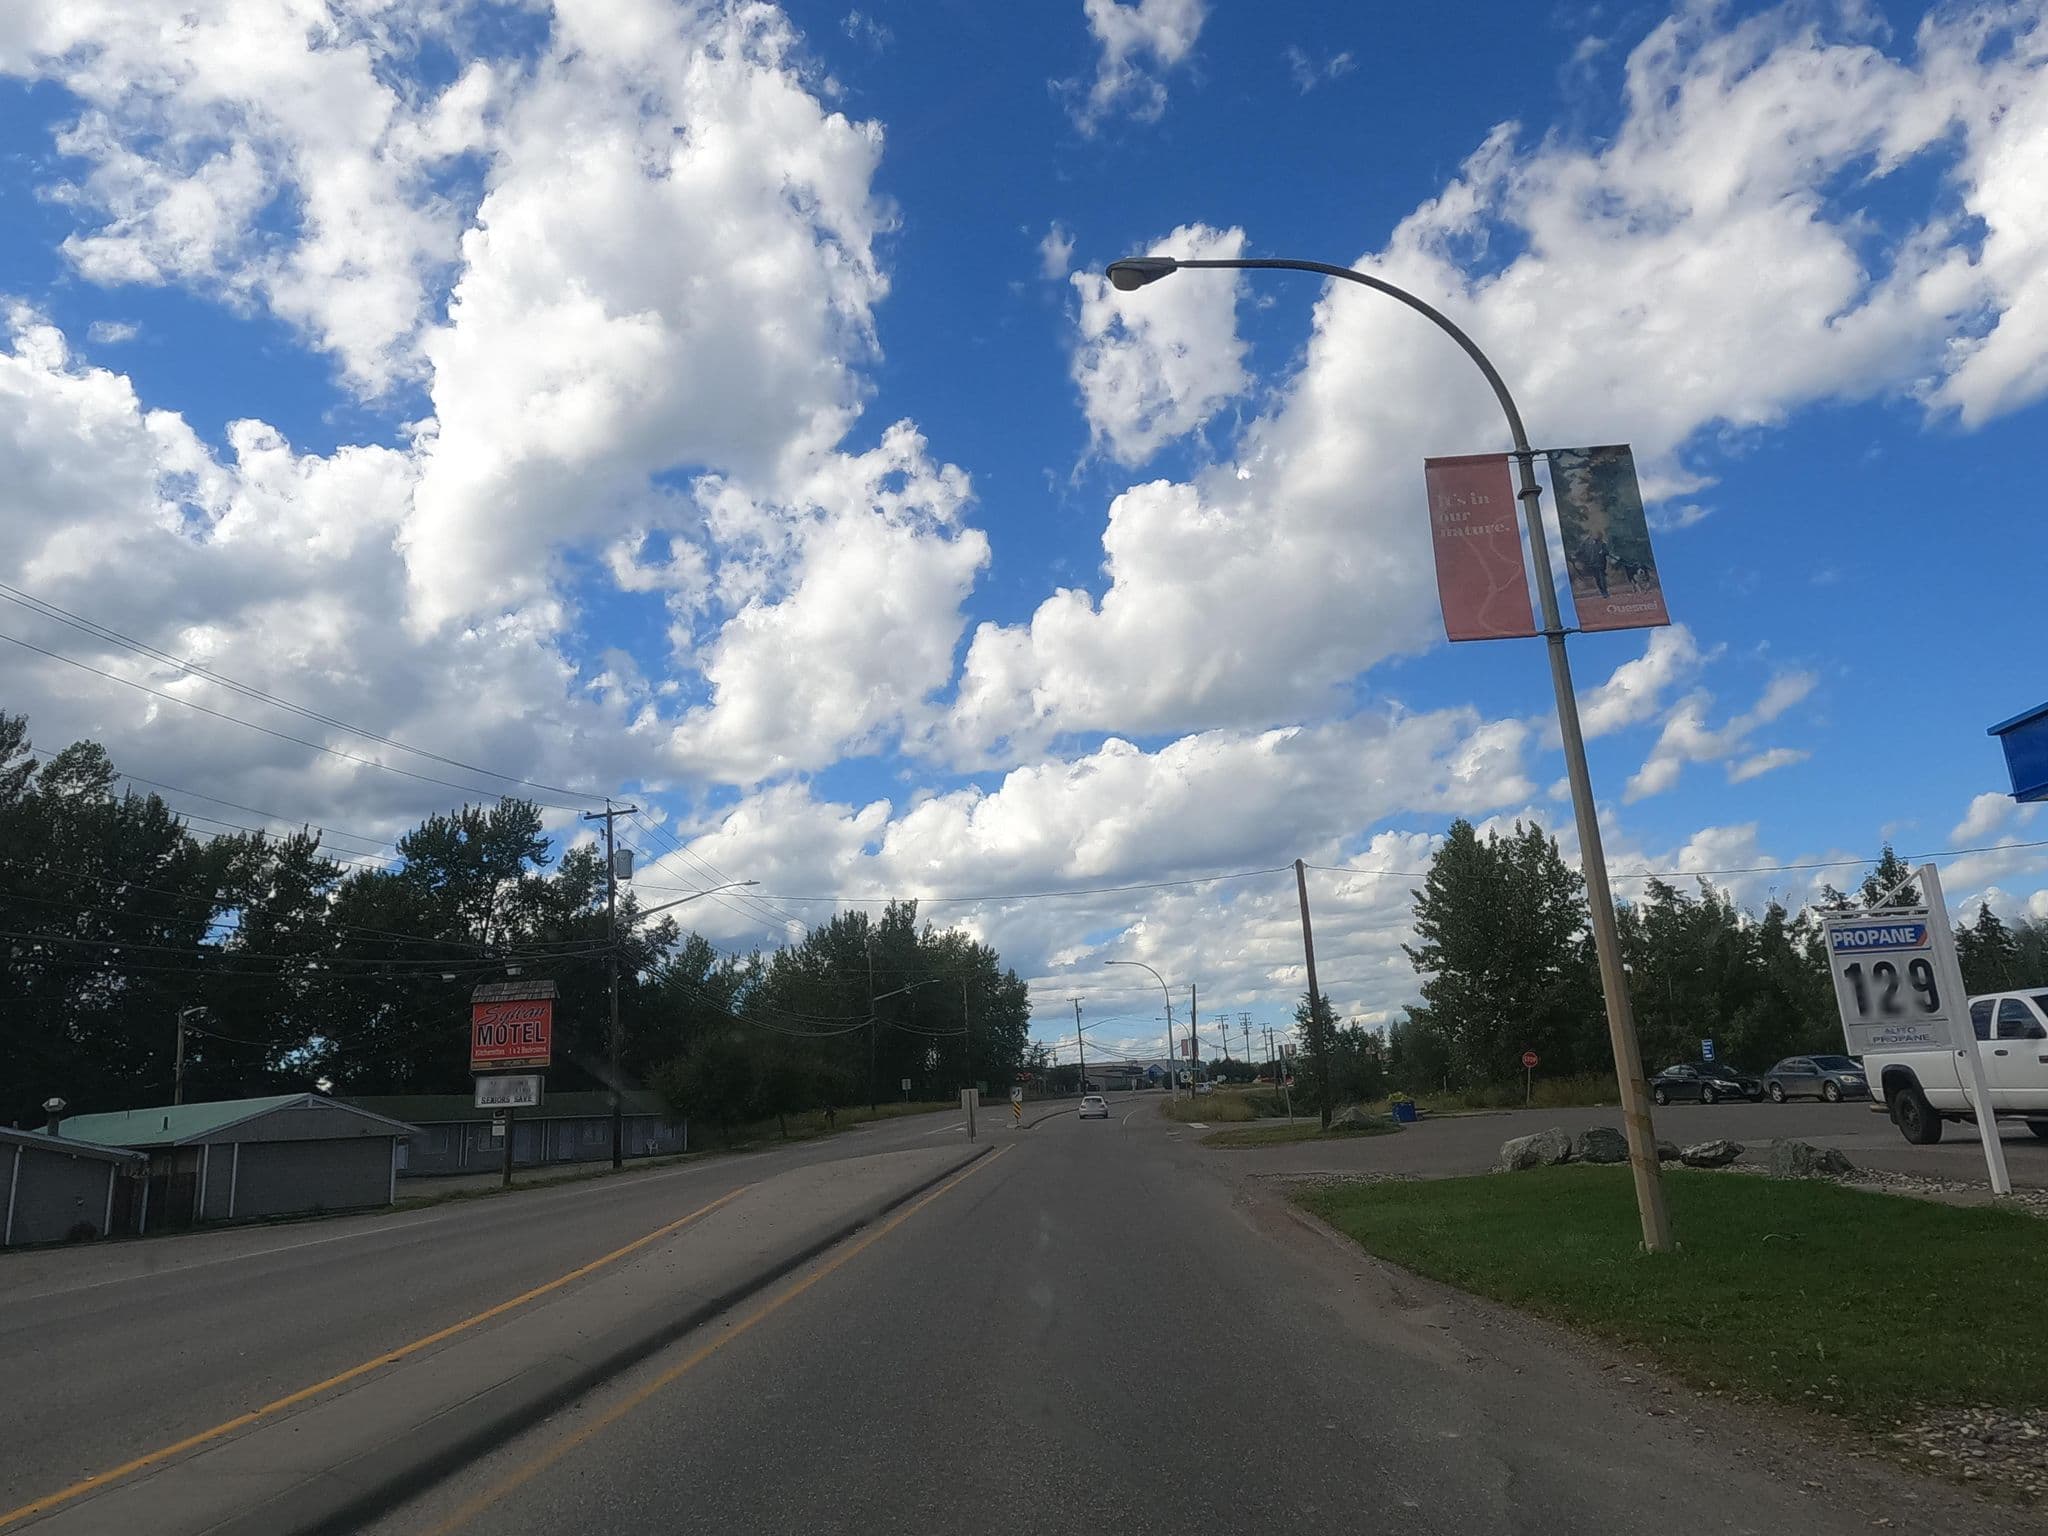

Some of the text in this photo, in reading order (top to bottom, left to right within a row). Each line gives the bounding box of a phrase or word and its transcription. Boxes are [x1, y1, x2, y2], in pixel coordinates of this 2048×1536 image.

[1470, 492, 1490, 505] in
[1439, 511, 1471, 521] our
[1832, 928, 1917, 947] PROPANE
[1844, 958, 1940, 1016] 129
[477, 1003, 546, 1025] Sylvan
[476, 1021, 547, 1047] MOTEL
[1873, 1034, 1931, 1043] PROPANE
[481, 1095, 533, 1104] SENIORS SAVE
